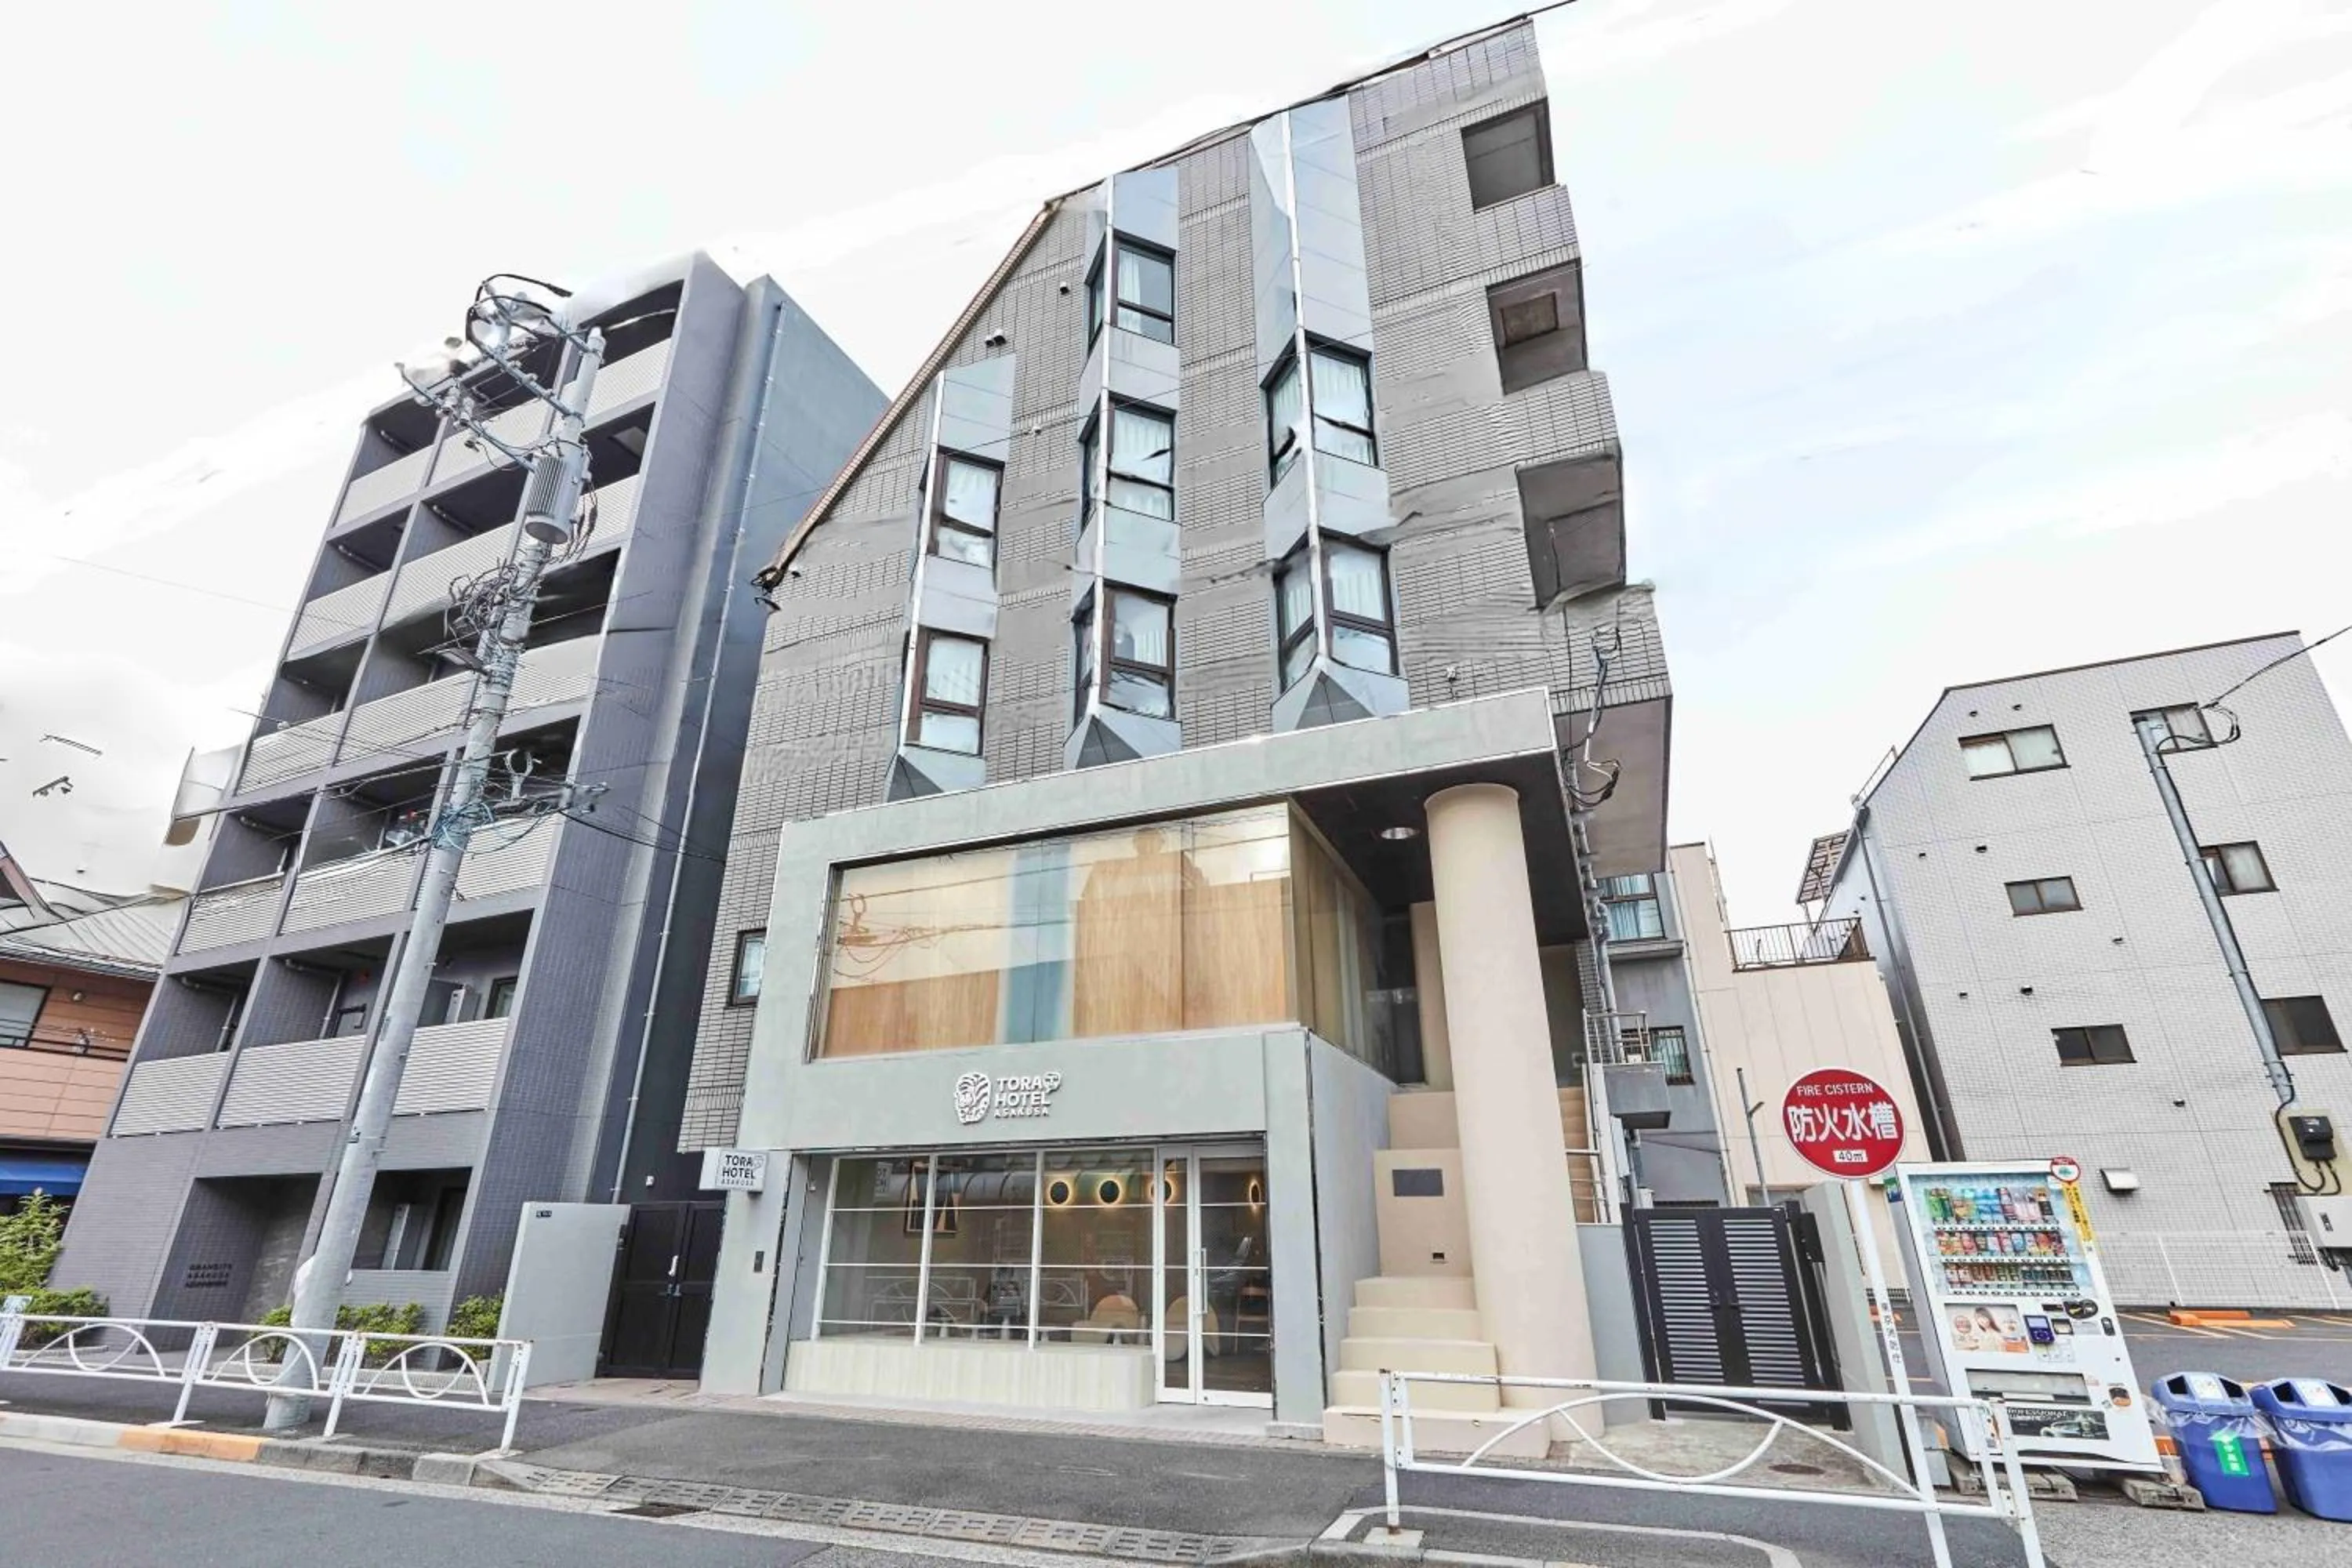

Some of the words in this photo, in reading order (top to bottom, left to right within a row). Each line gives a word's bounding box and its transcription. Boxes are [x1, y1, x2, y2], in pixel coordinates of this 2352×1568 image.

[996, 1076, 1043, 1092] TORA
[1796, 1084, 1823, 1096] FIRE
[1824, 1082, 1874, 1095] CISTERN
[994, 1091, 1051, 1107] HOTEL
[993, 1106, 1050, 1118] ASAKUSA
[1787, 1101, 1899, 1142] 防火水槽
[725, 1154, 753, 1167] TORA
[722, 1167, 756, 1179] HOTEL
